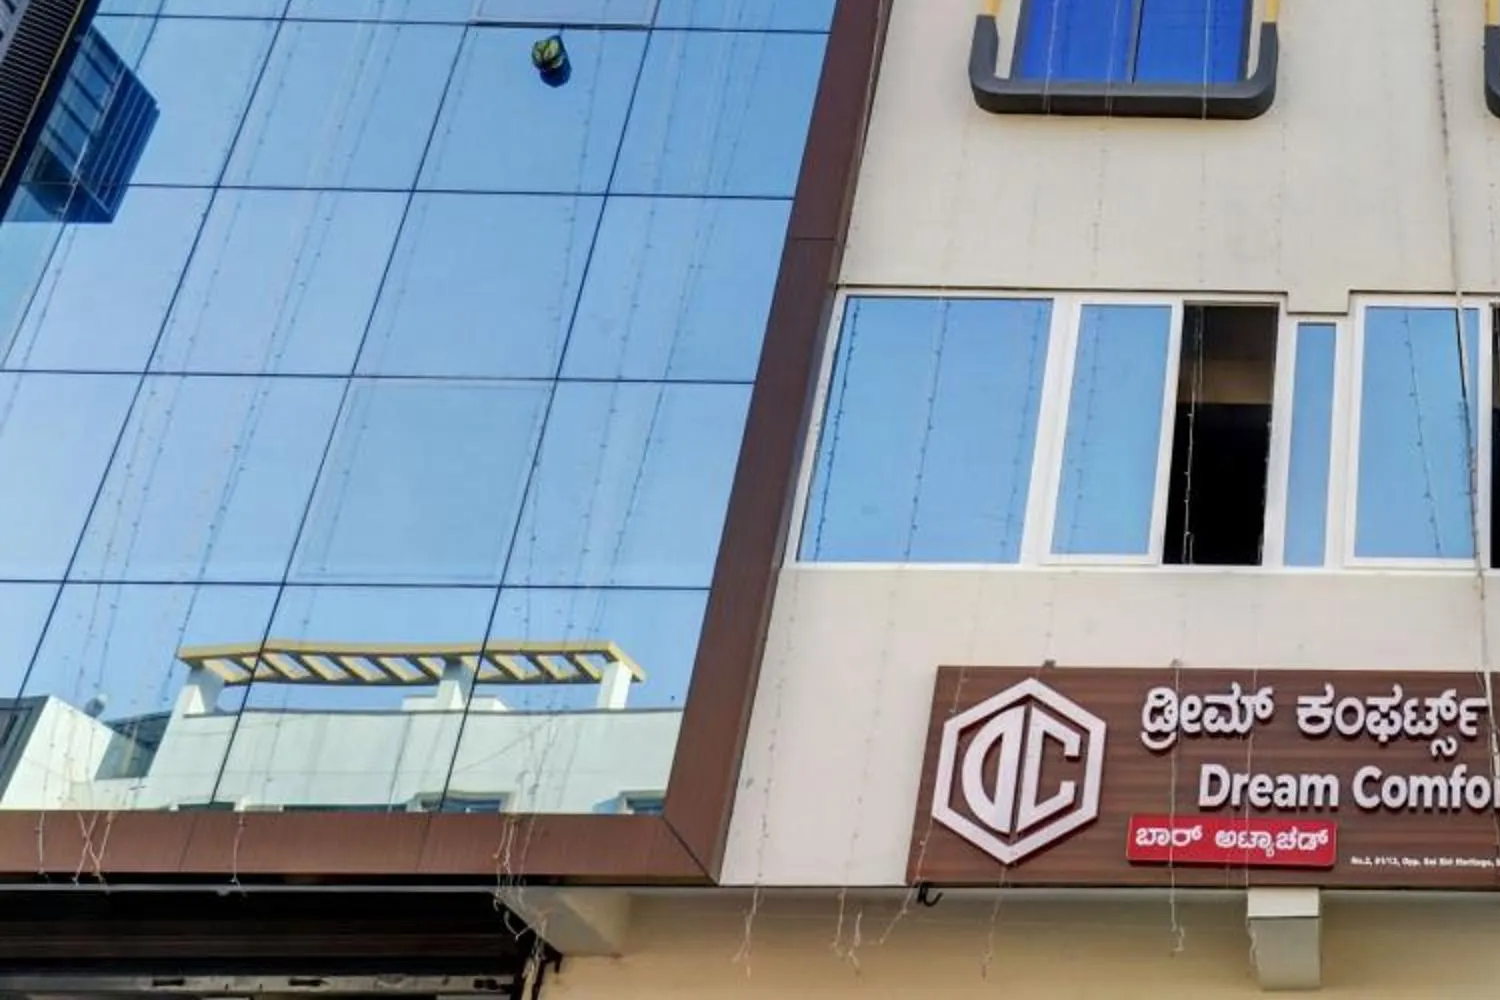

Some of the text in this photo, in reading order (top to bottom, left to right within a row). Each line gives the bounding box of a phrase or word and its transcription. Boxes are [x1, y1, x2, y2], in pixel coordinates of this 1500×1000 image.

[1141, 681, 1274, 750] ಡ್ರೀಮ್
[1199, 763, 1339, 808] Dream
[1135, 824, 1203, 847] ಬಾರ್
